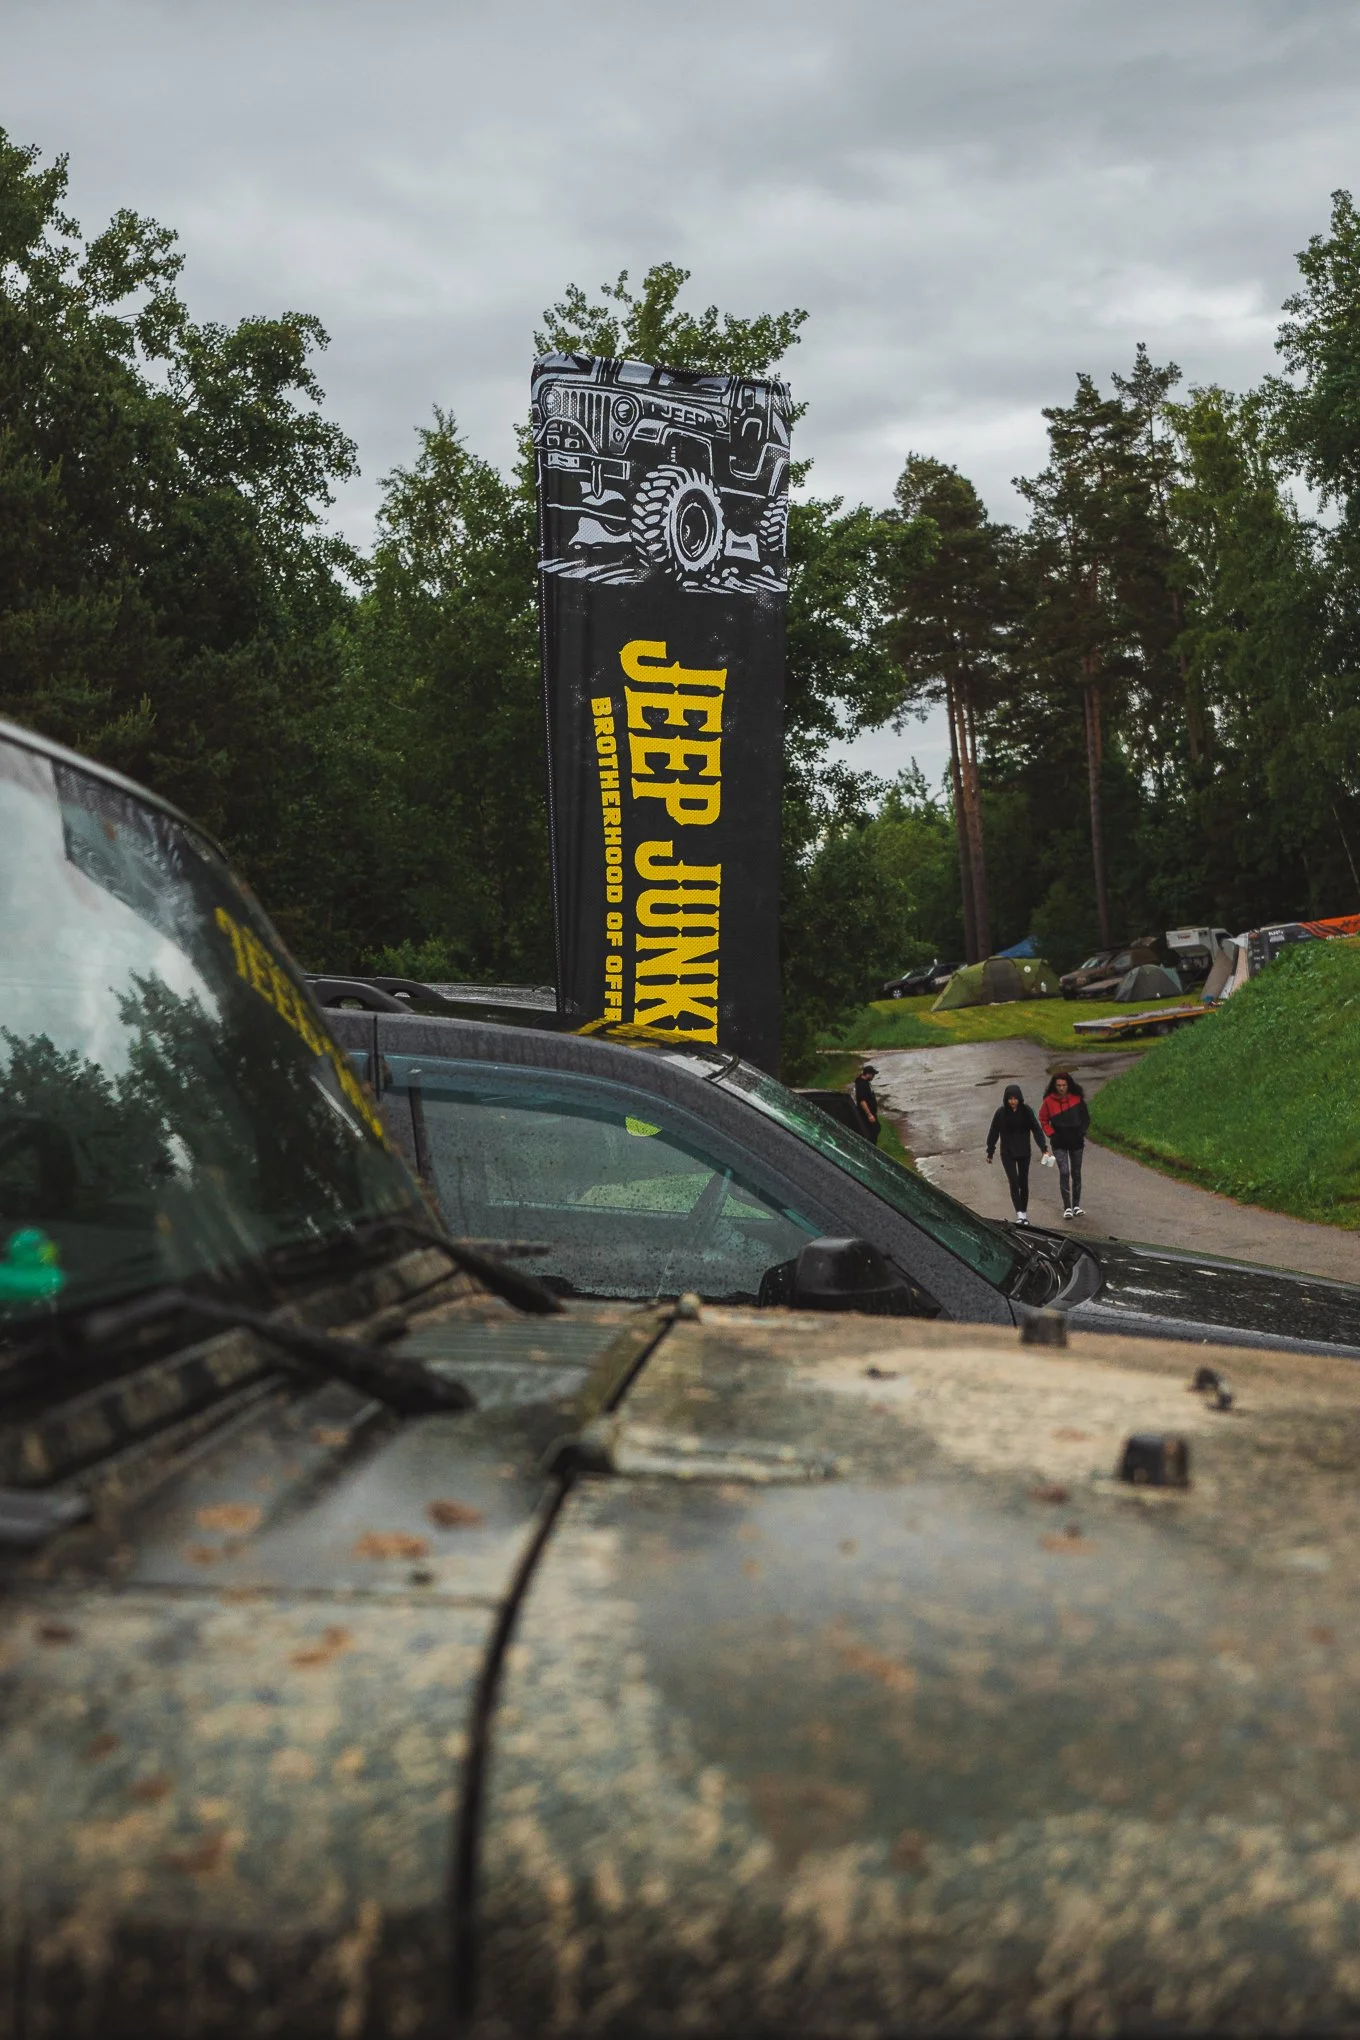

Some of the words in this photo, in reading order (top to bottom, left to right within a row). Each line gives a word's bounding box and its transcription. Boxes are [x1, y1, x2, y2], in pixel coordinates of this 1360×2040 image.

[661, 405, 707, 425] JEEP
[621, 640, 727, 825] JEEP
[592, 697, 622, 903] BROTHERHOOD
[606, 911, 622, 946] OF
